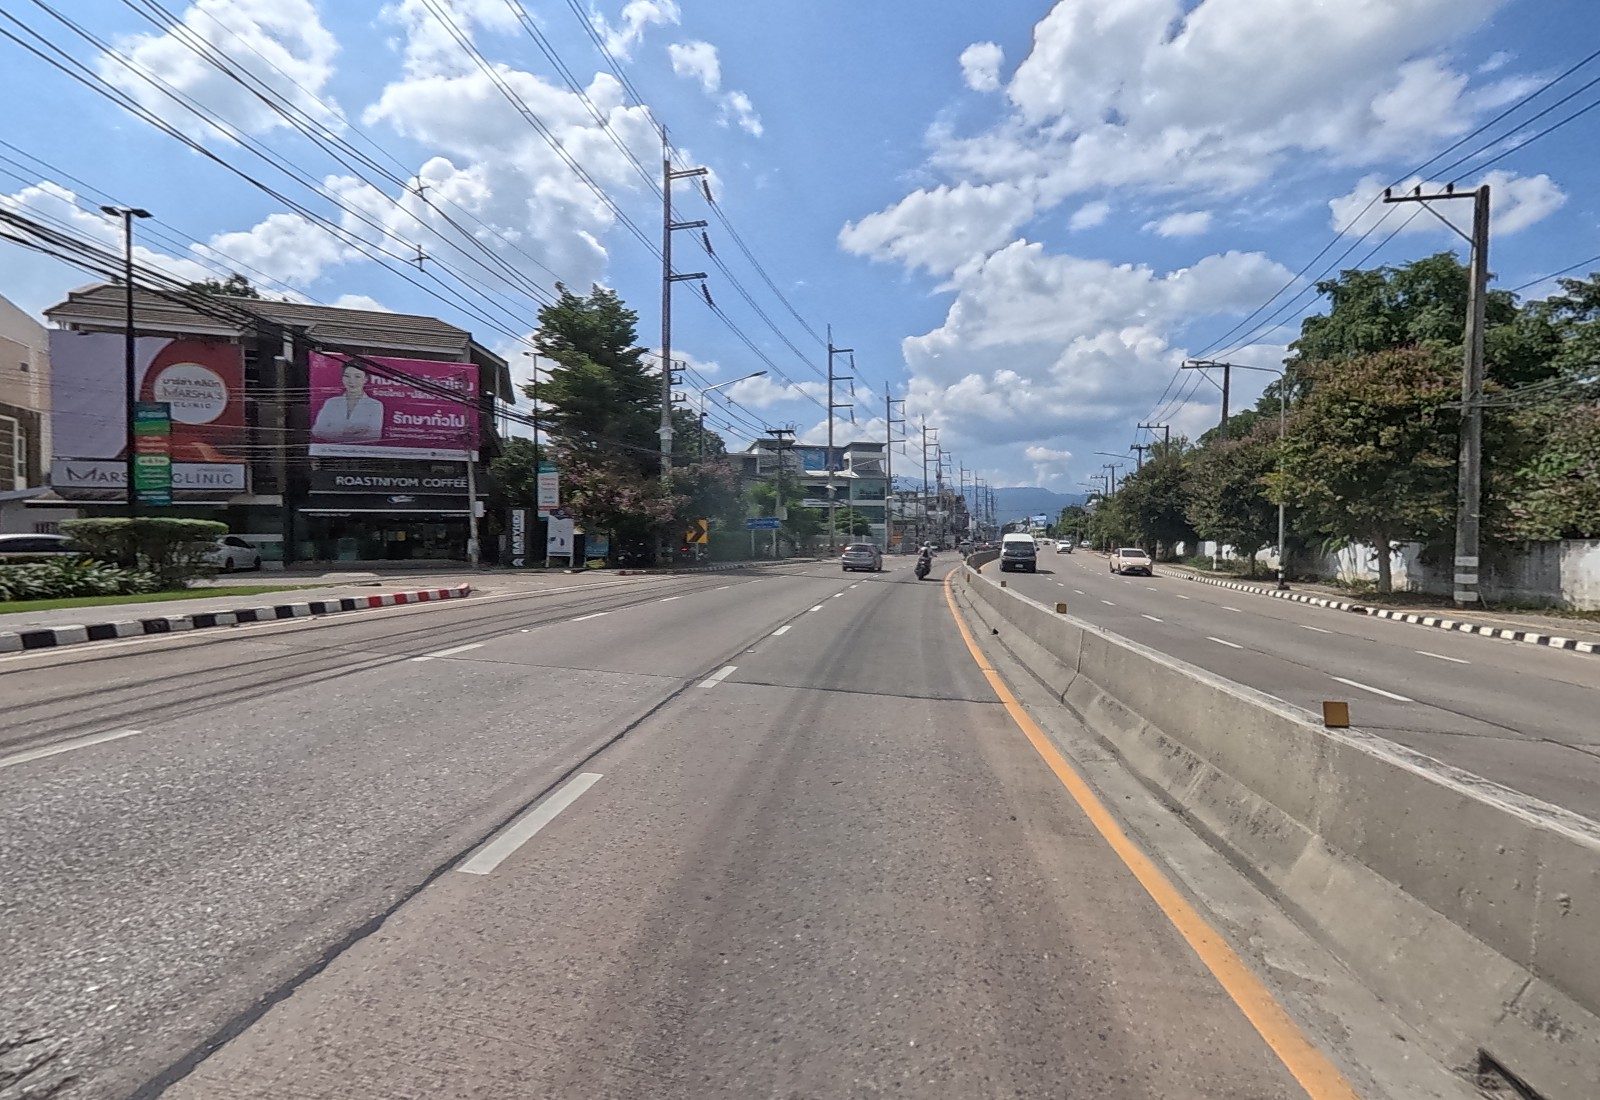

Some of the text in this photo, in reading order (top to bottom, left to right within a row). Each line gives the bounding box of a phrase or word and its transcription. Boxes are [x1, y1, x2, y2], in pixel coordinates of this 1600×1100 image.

[173, 401, 211, 409] CLINIC
[393, 409, 465, 428] รักษาทั่วไป
[172, 472, 234, 484] CLINIC
[336, 476, 468, 488] ROASTNIYOM COFFEE
